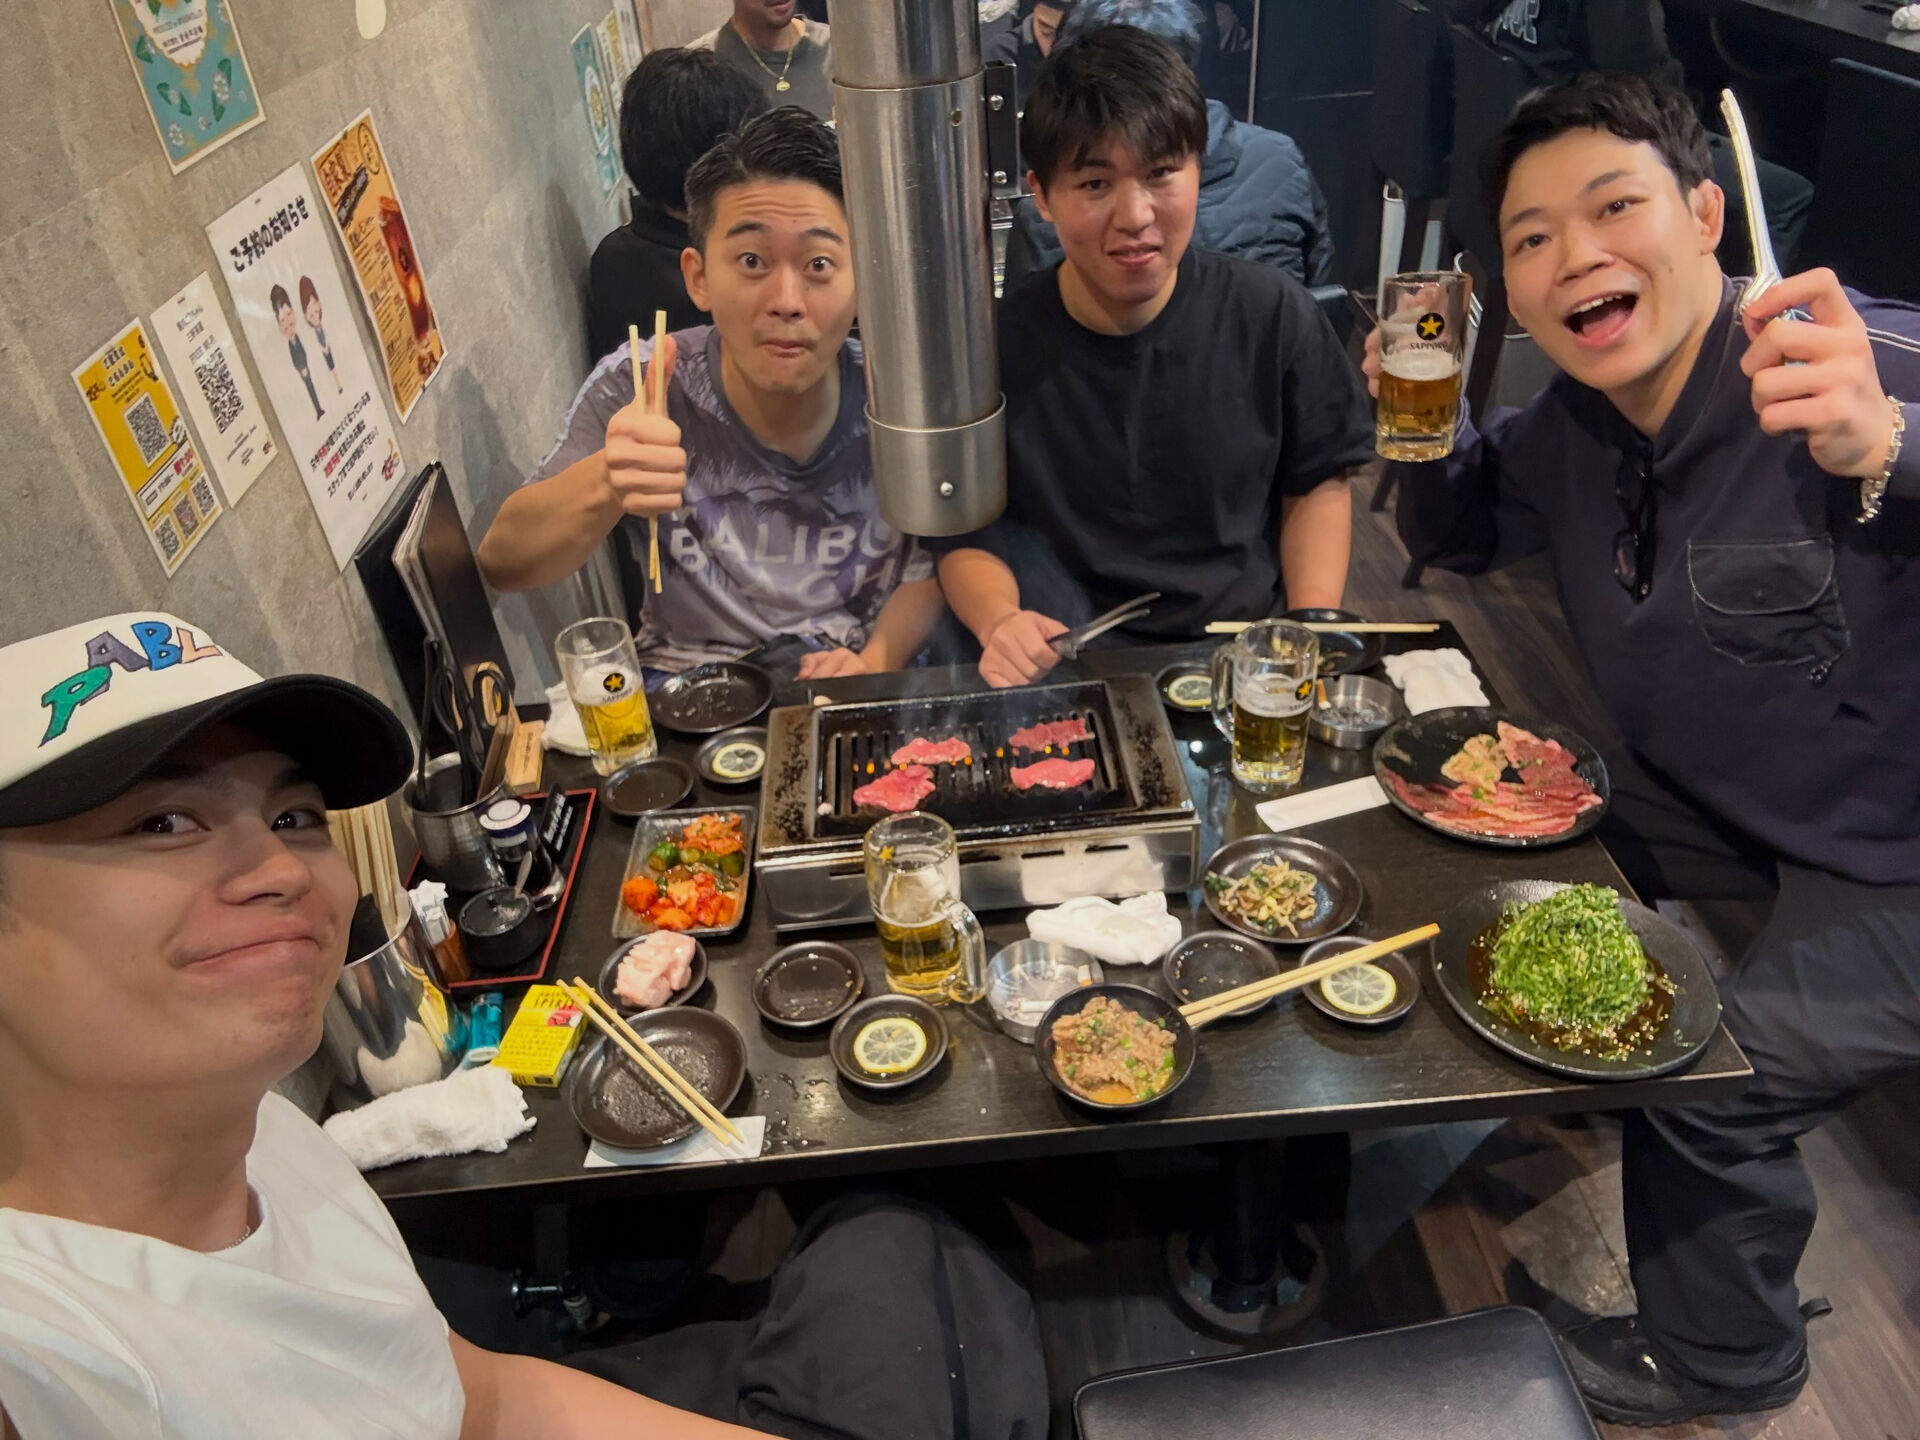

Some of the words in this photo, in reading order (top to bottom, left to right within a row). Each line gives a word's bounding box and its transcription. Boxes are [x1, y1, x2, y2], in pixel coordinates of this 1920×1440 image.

[230, 195, 309, 273] ご予約のお知らせ
